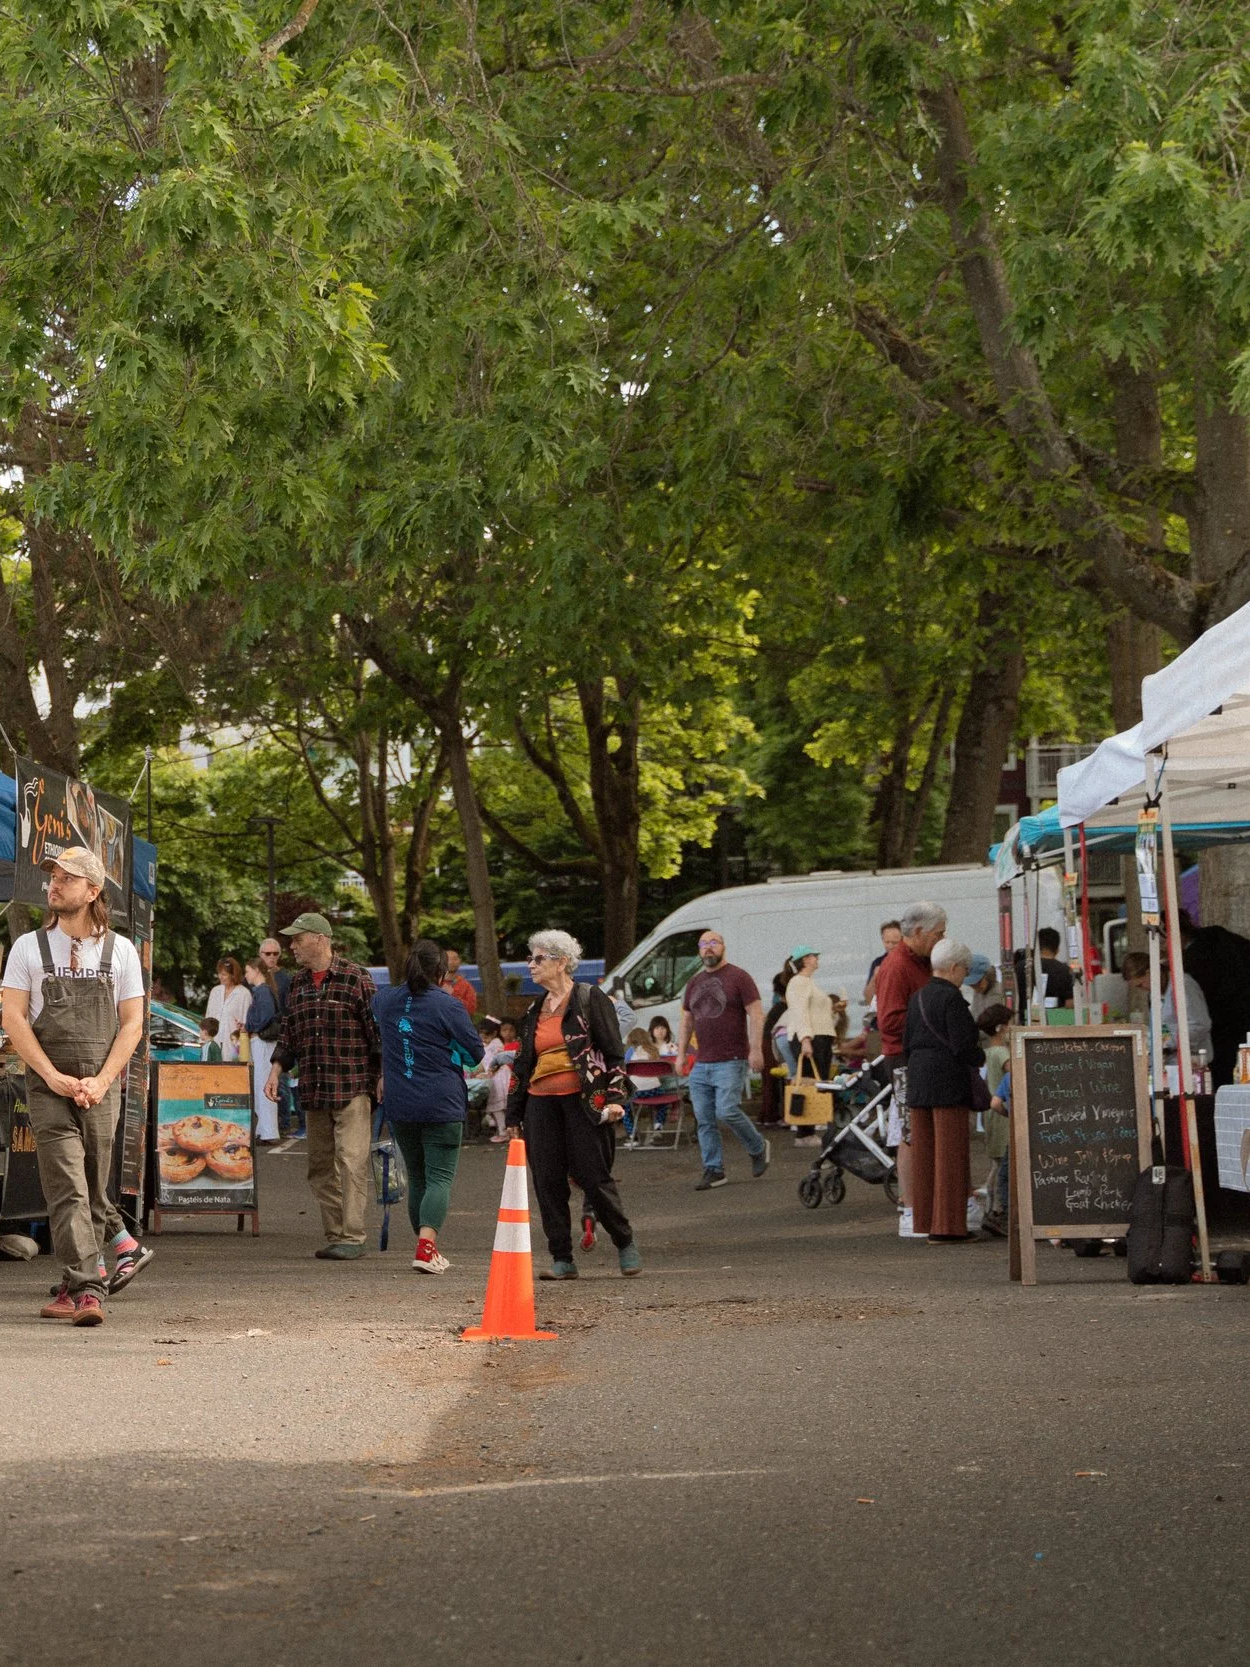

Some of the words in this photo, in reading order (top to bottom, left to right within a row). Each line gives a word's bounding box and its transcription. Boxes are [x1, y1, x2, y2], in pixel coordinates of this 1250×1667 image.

[178, 1195, 203, 1205] Pastéis
[203, 1195, 213, 1204] de
[214, 1195, 232, 1204] Nata
